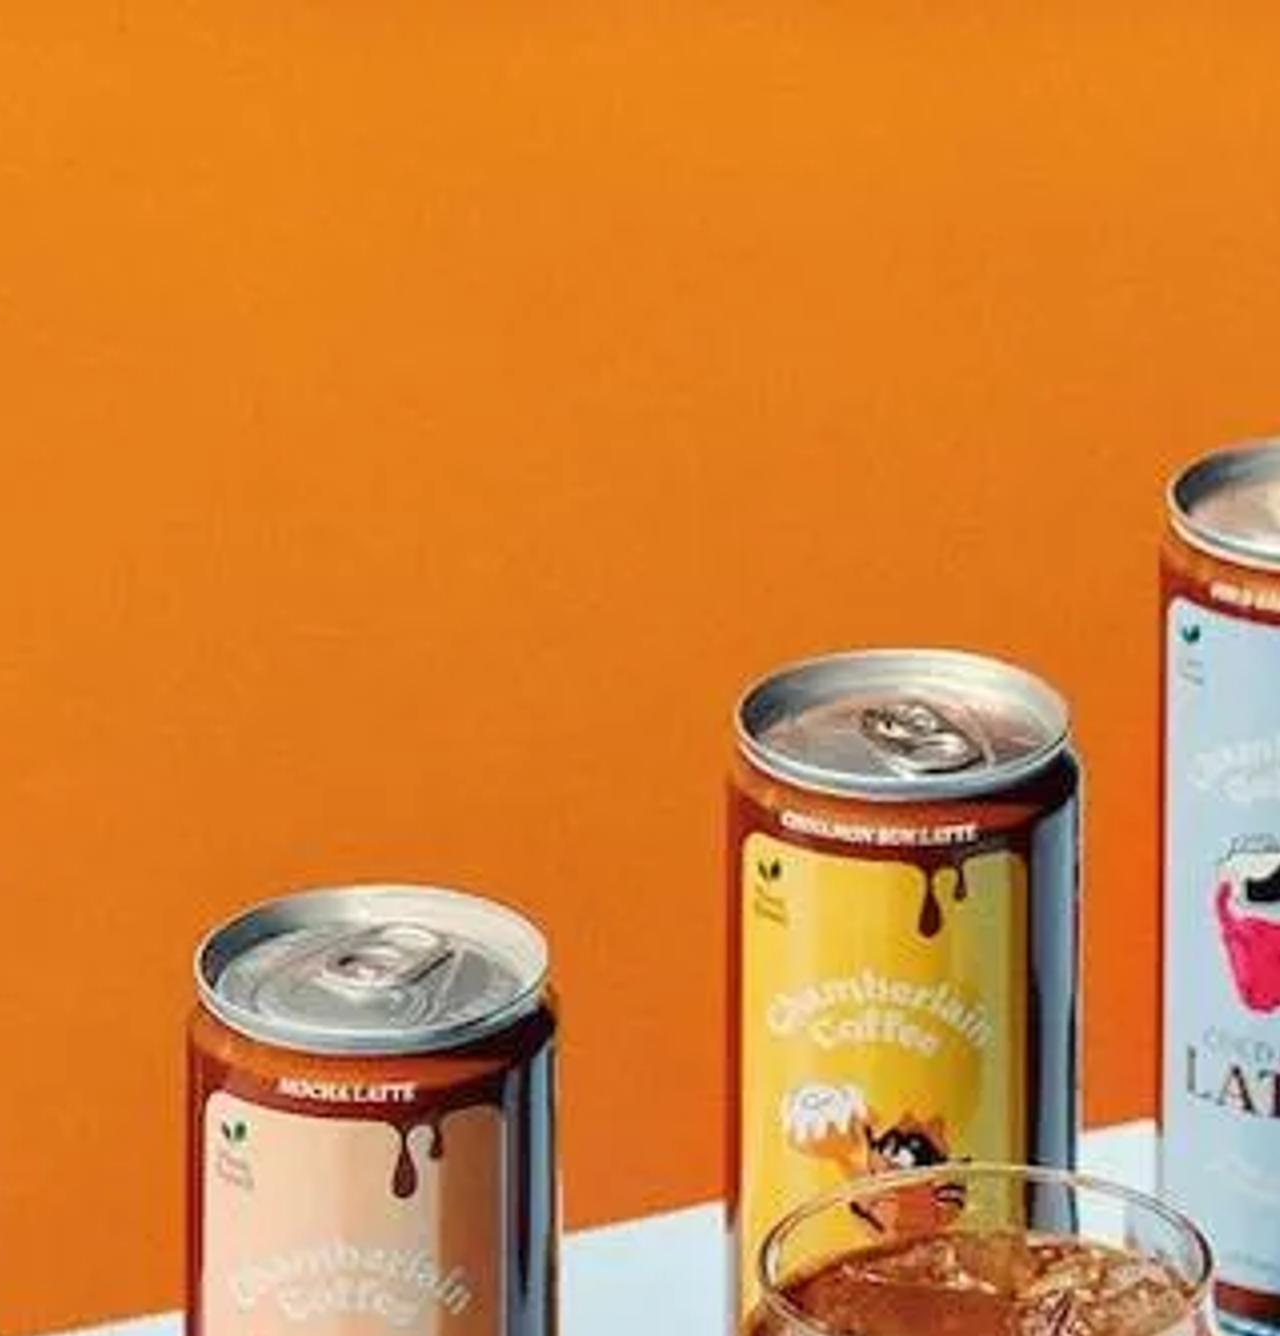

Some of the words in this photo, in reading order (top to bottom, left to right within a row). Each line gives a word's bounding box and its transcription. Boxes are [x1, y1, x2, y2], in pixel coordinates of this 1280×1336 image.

[767, 967, 994, 1048] Chamberlain
[813, 1008, 940, 1058] Coffee
[277, 1076, 350, 1102] MOCHA
[354, 1081, 417, 1103] LATTE
